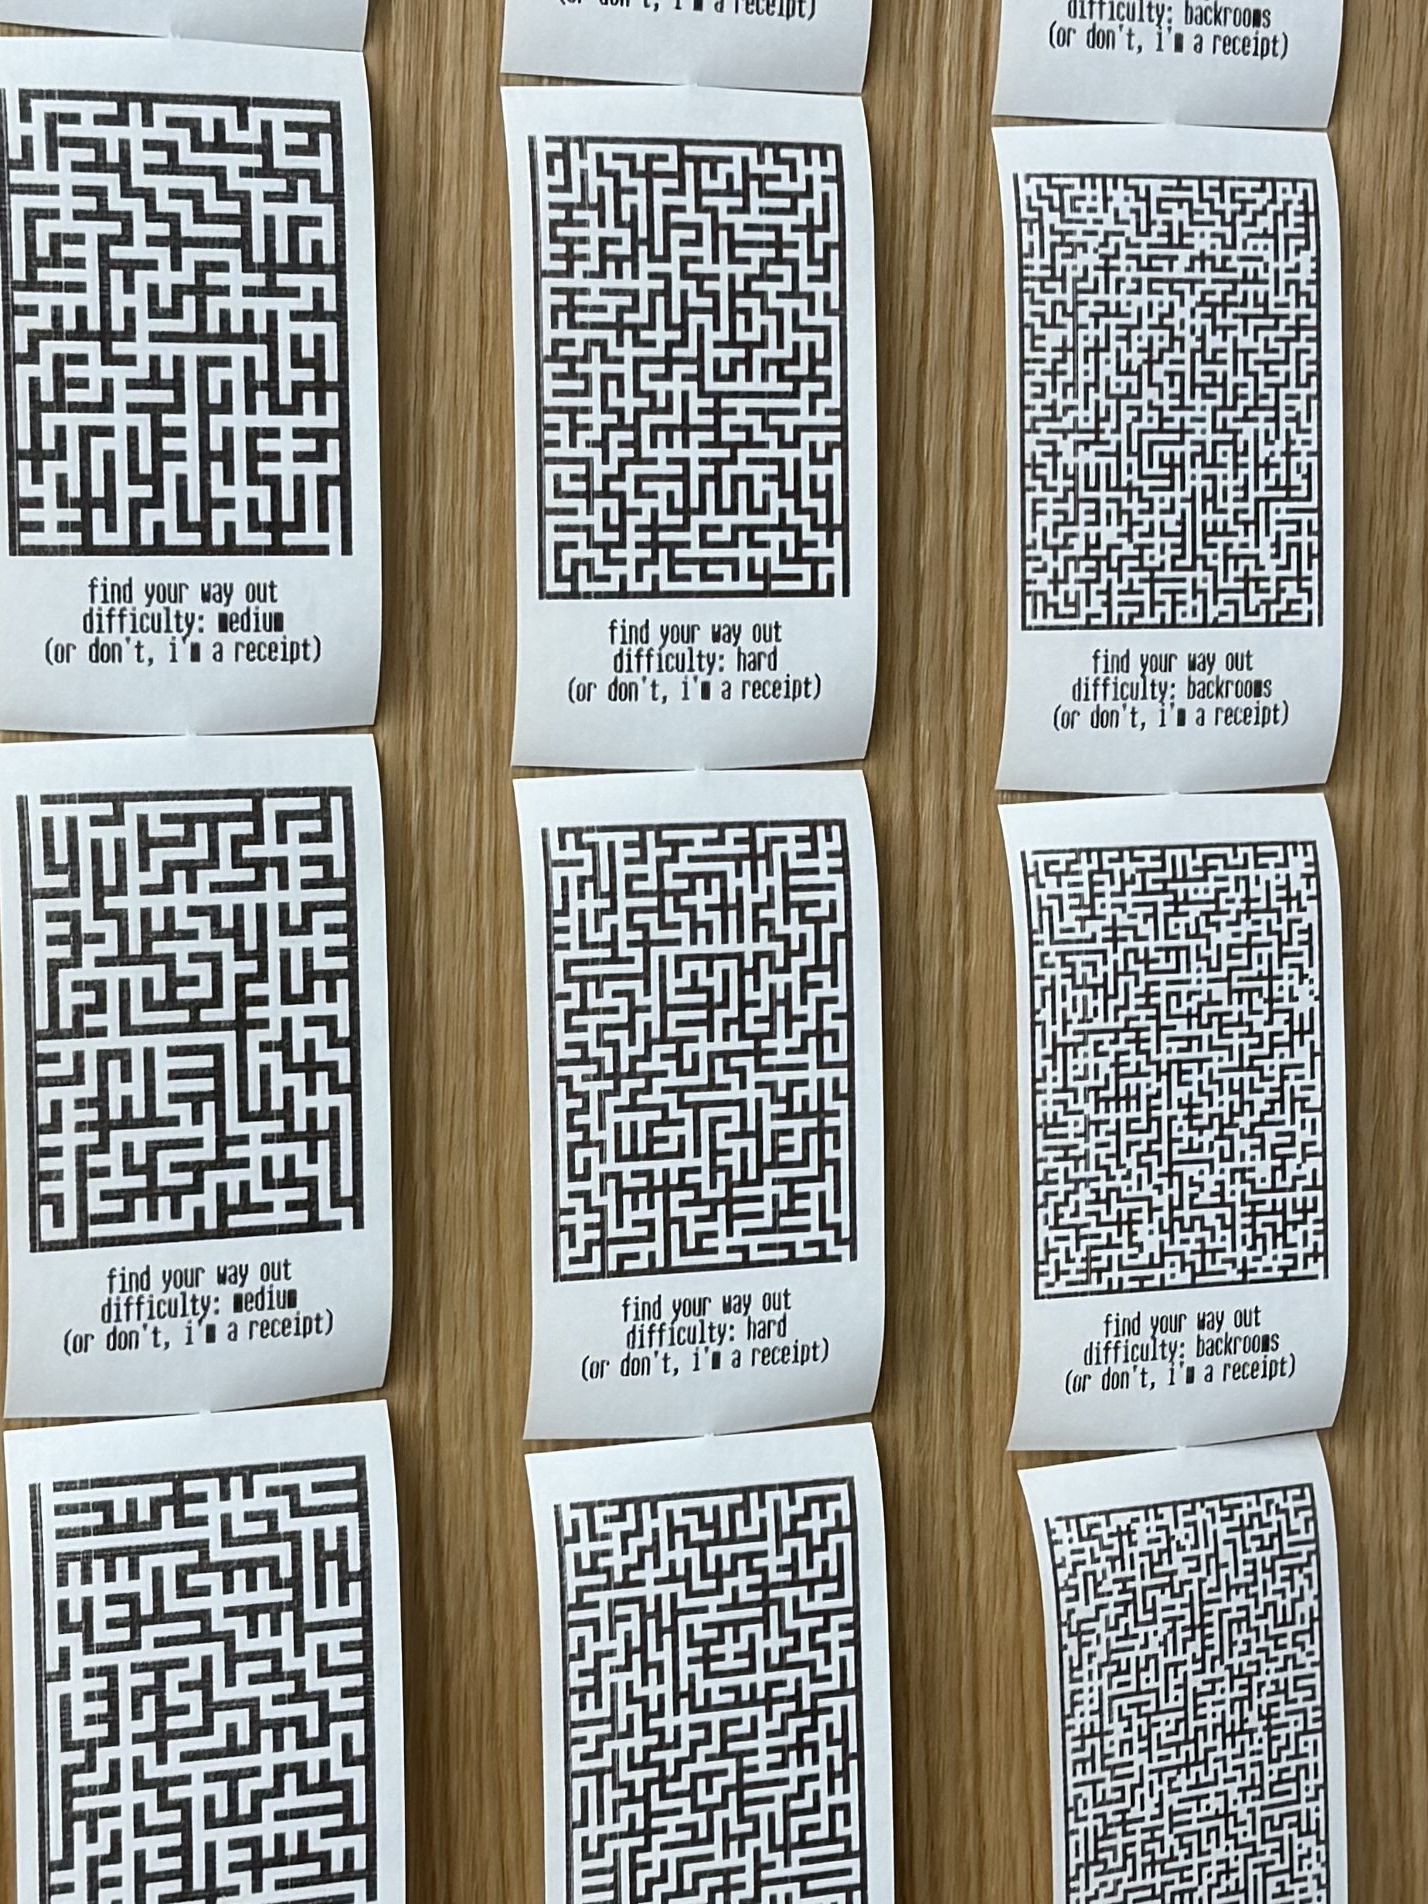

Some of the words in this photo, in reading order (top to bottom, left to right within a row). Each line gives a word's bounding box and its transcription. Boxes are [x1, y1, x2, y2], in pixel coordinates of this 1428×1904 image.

[88, 576, 133, 604] find
[145, 583, 189, 607] your
[201, 583, 233, 607] way
[246, 580, 277, 603] out
[609, 618, 649, 645] find
[660, 624, 700, 649] your
[712, 624, 741, 647] way
[752, 621, 782, 643] out
[614, 646, 724, 676] difficulty:
[737, 645, 777, 672] hard
[1092, 648, 1130, 674] find
[1140, 653, 1177, 677] your
[1188, 653, 1216, 675] way
[1226, 650, 1253, 671] out
[107, 1265, 150, 1294] find
[162, 1267, 205, 1294] your
[217, 1264, 248, 1288] way
[260, 1258, 292, 1282] out
[622, 1294, 661, 1322] find
[672, 1297, 711, 1323] your
[722, 1293, 751, 1317] way
[762, 1288, 791, 1312] out
[627, 1319, 734, 1350] difficulty:
[747, 1312, 786, 1341] hard
[1104, 1311, 1140, 1338] find
[1151, 1314, 1187, 1339] your
[1197, 1310, 1224, 1333] way
[1234, 1305, 1261, 1328] out
